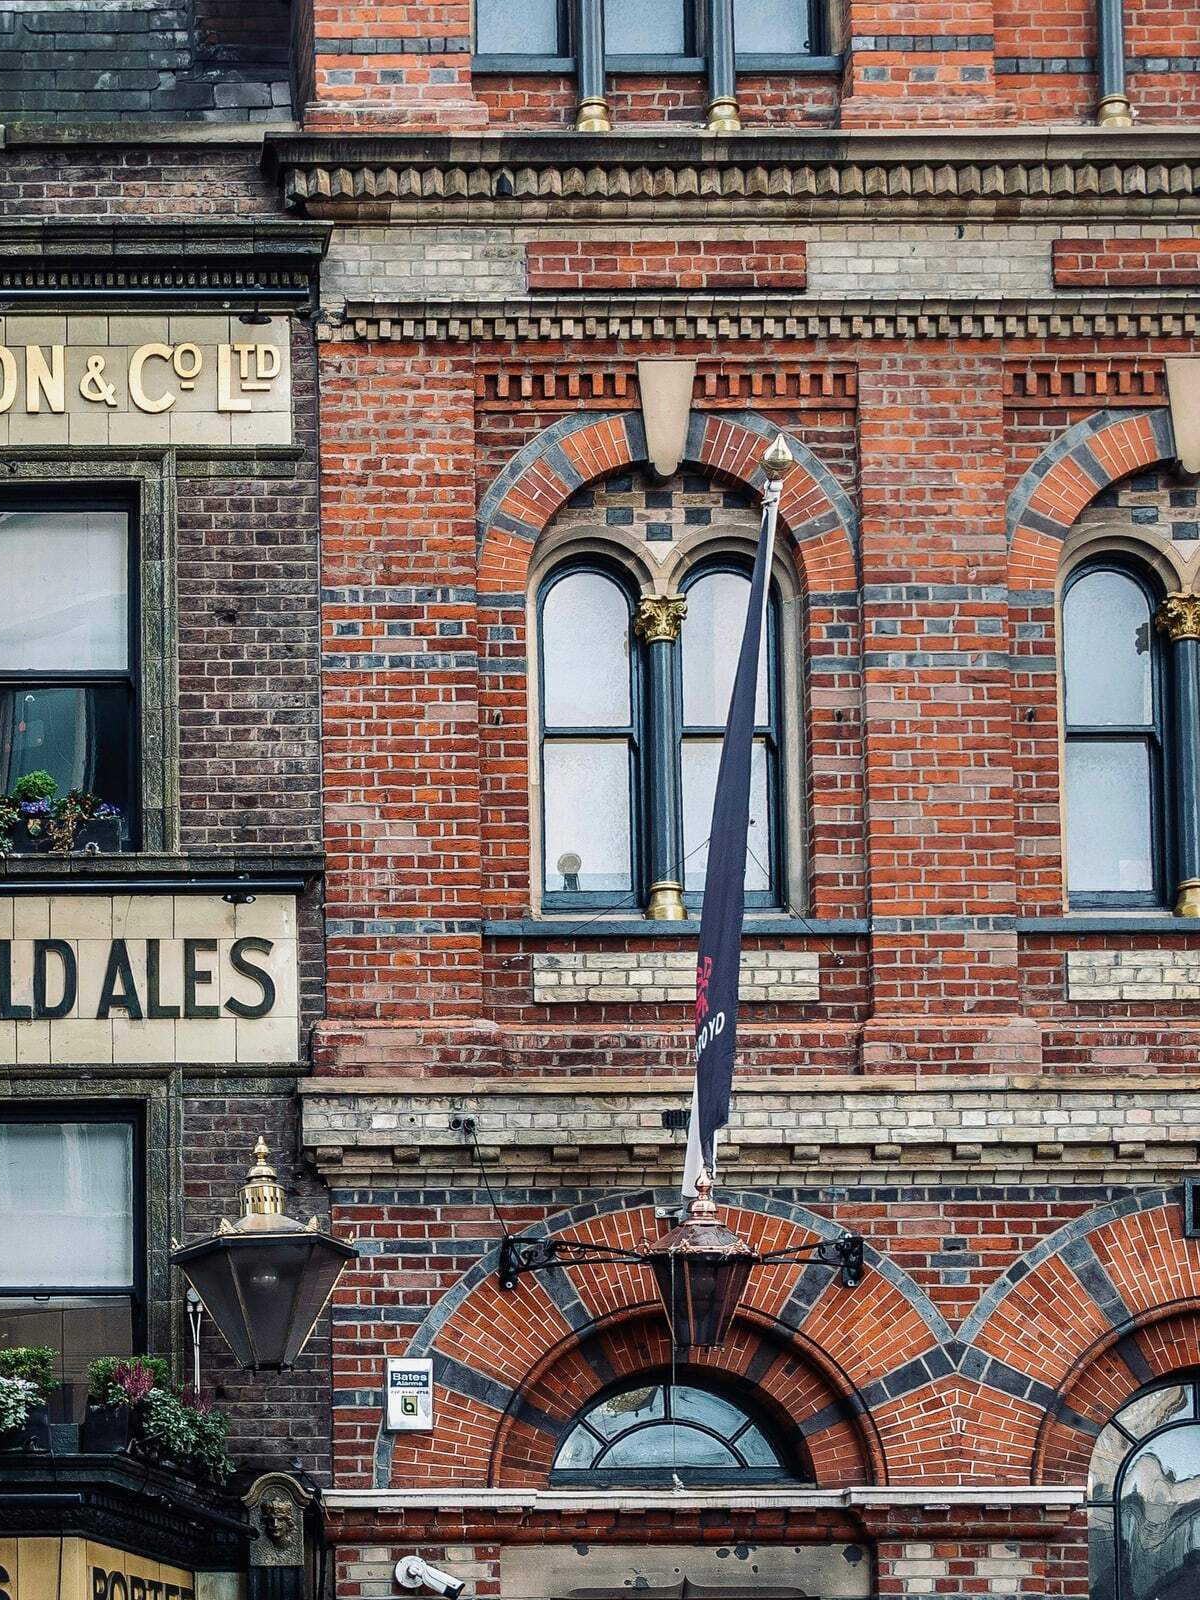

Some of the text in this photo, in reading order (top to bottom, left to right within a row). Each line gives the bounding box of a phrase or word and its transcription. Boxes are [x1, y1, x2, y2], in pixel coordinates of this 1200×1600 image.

[79, 354, 117, 406] &
[218, 342, 282, 412] LTD
[96, 936, 277, 1020] ALES
[392, 1373, 428, 1381] Bates
